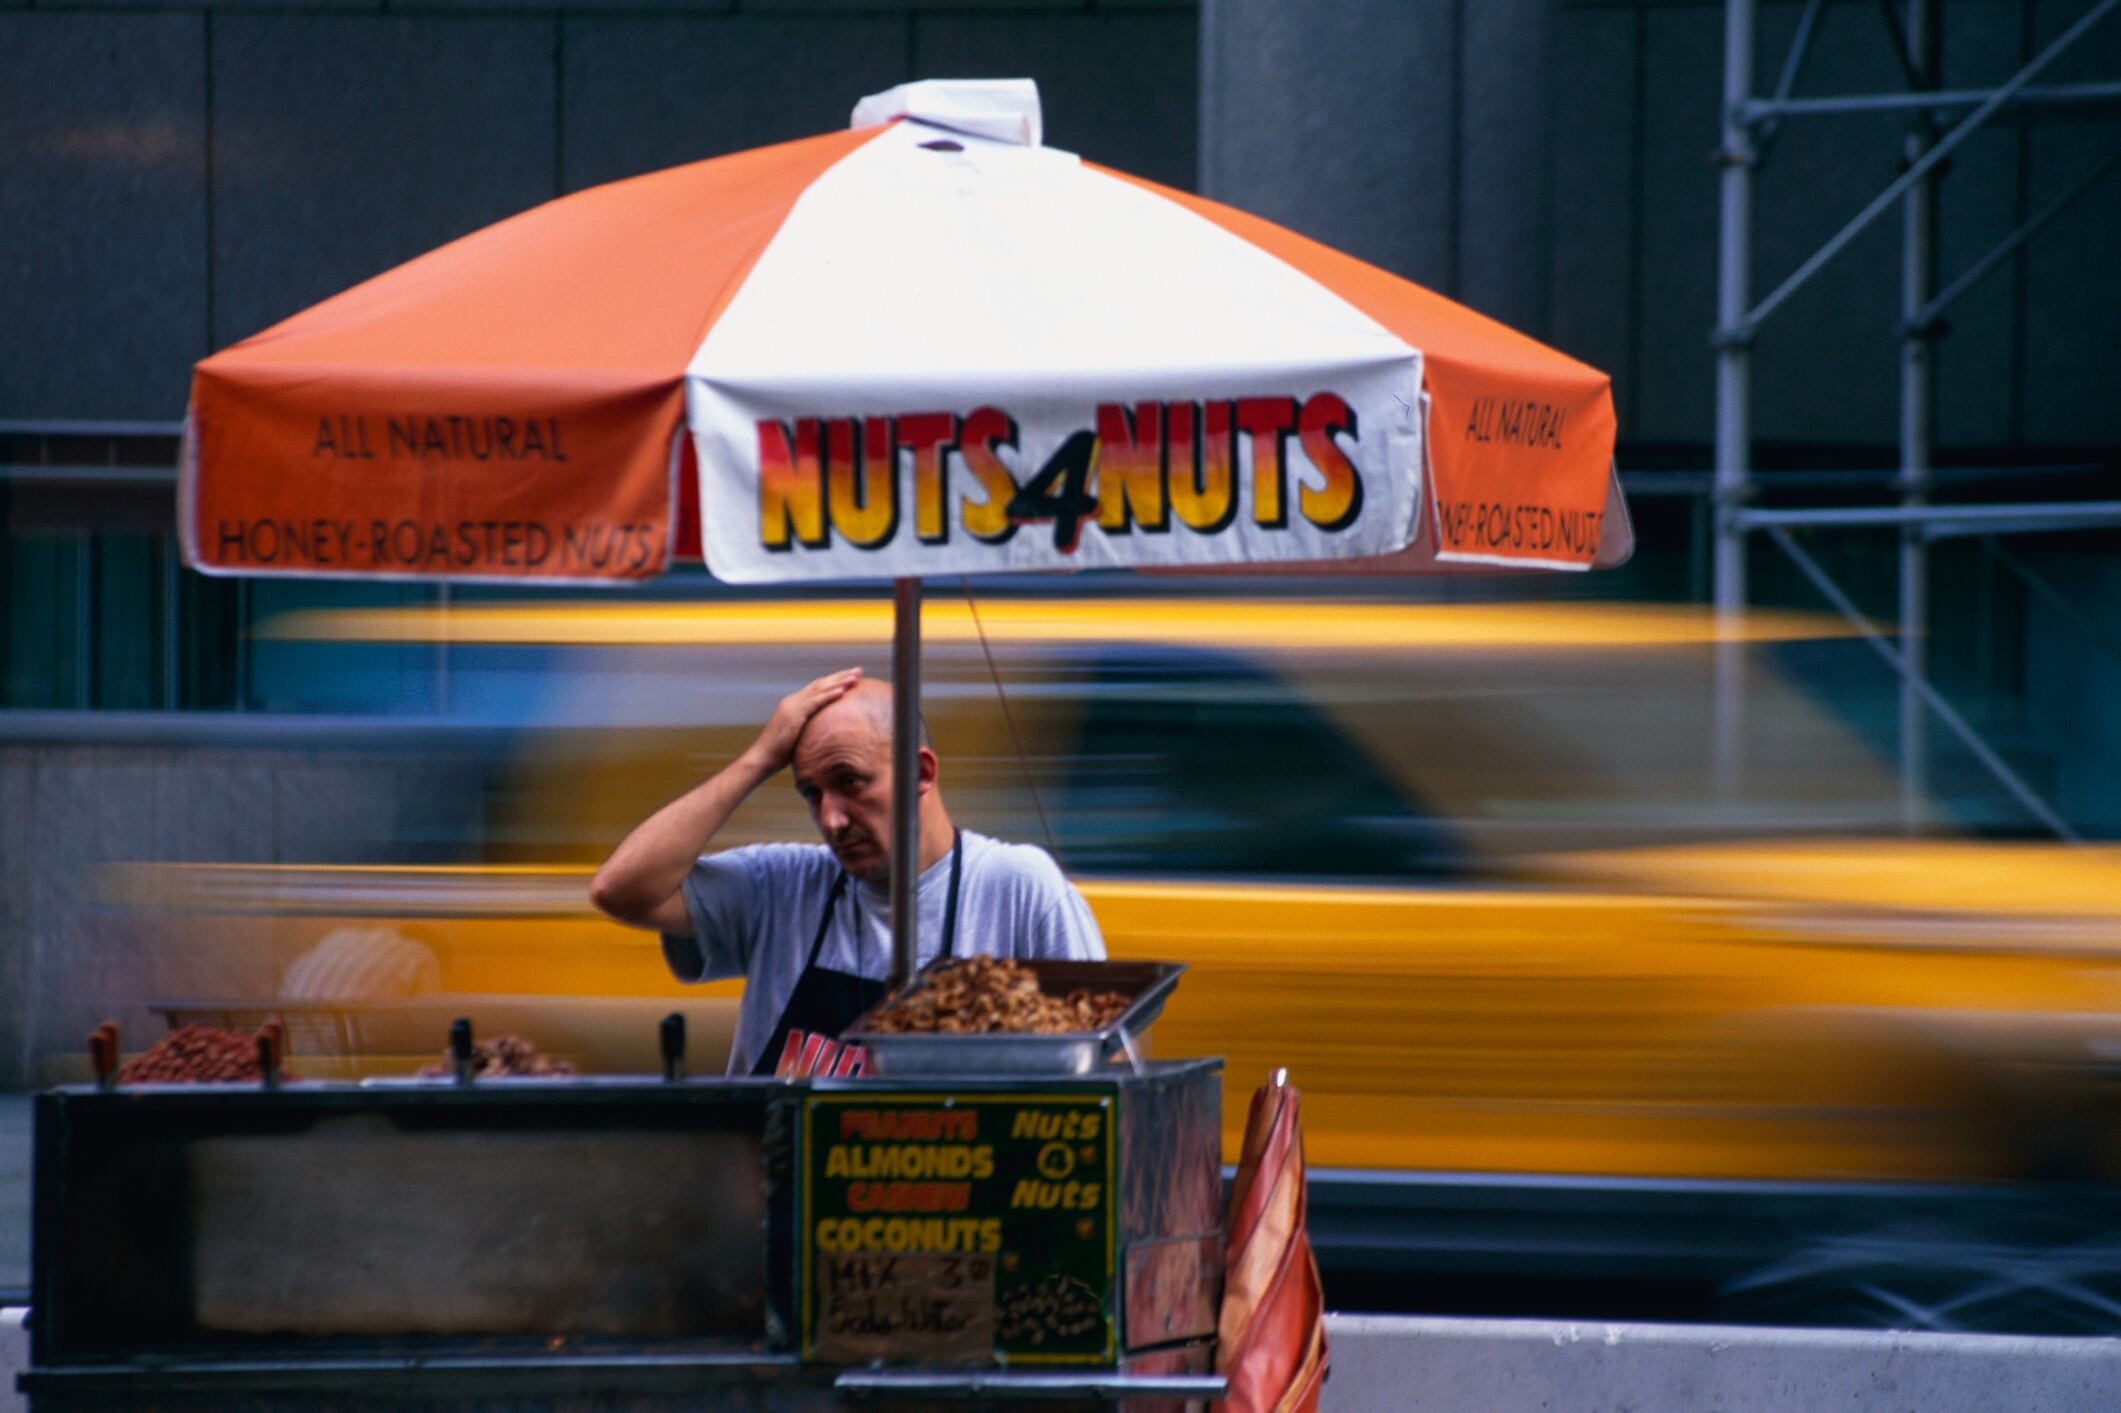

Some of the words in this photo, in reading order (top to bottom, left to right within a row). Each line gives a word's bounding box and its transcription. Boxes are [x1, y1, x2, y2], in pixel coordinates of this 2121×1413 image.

[313, 415, 373, 460] ALL
[388, 417, 567, 462] NATURAL
[1467, 398, 1494, 442] ALL
[1498, 401, 1566, 449] NATURAL
[757, 406, 1020, 551] NUTS
[1006, 430, 1099, 556] 4
[1096, 391, 1364, 535] NUTS
[1437, 501, 1553, 550] NEY-ROASTED
[218, 518, 553, 566] HONEY-ROASTED
[562, 524, 653, 569] NUTS
[840, 1110, 979, 1141] PEANUTS
[1010, 1109, 1101, 1140] Nuts
[825, 1145, 994, 1178] ALMONDS
[846, 1181, 972, 1213] CASHEW
[1010, 1178, 1101, 1210] Nuts
[816, 1218, 1002, 1252] COCONUTS
